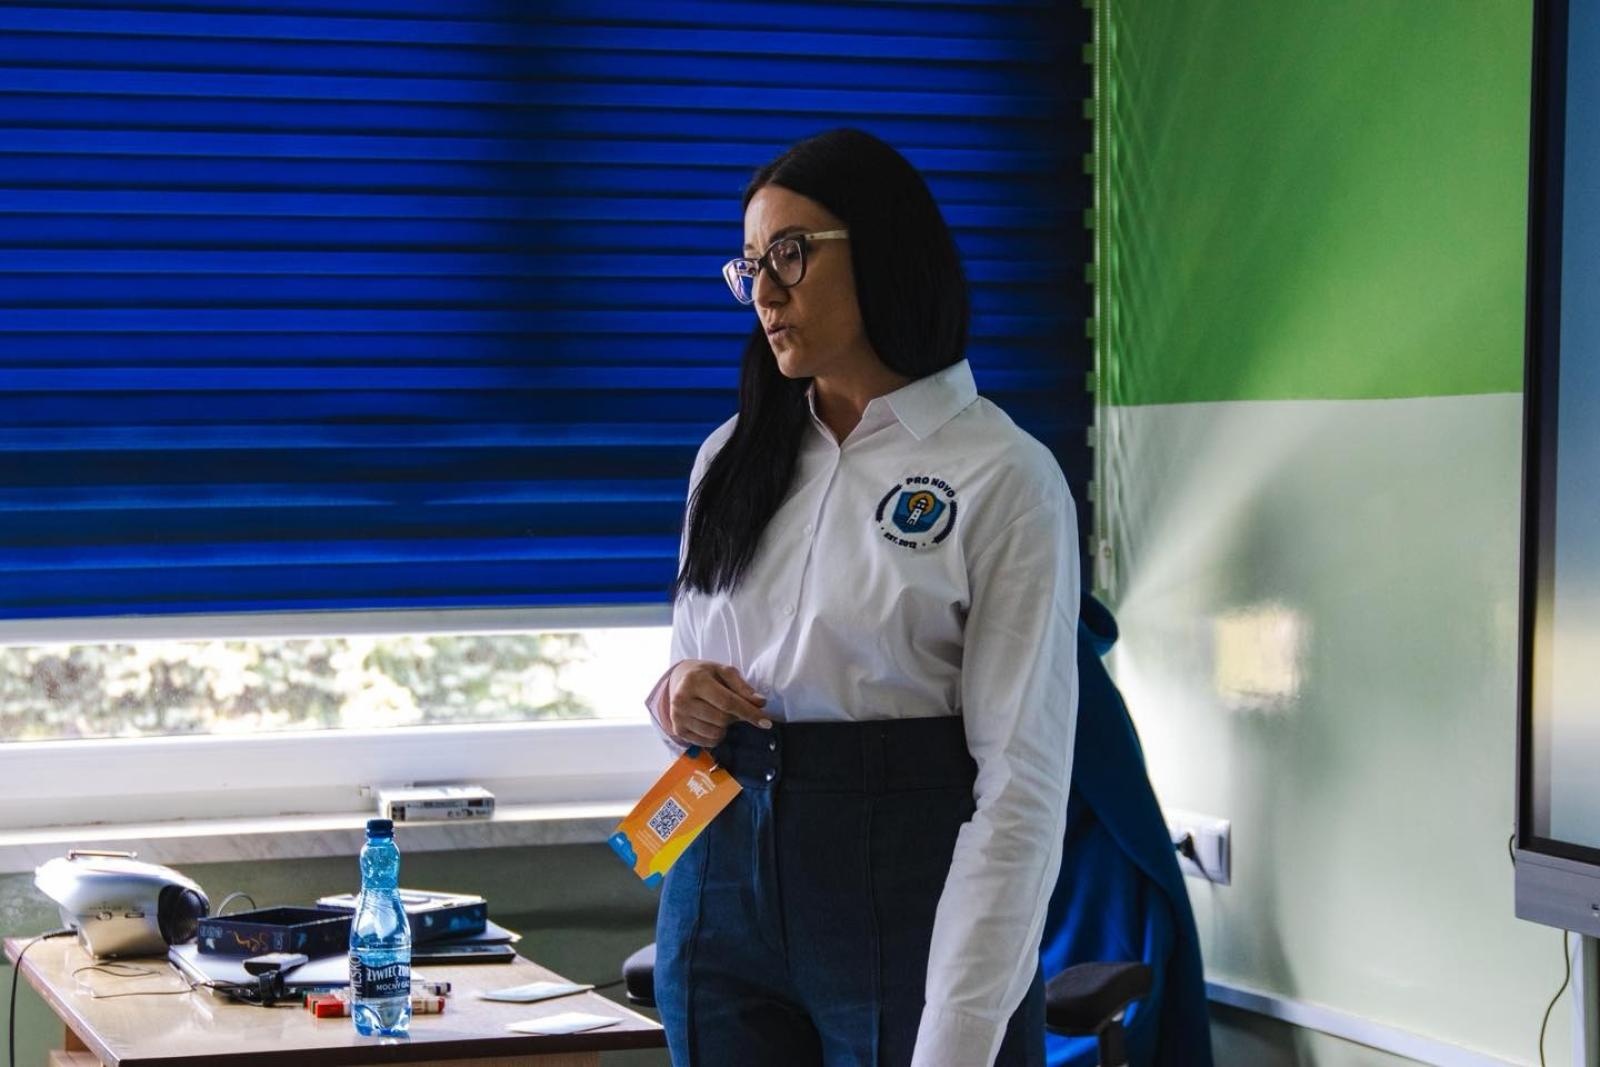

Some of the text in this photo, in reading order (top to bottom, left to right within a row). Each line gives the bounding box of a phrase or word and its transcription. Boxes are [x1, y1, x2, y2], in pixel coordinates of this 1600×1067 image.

[906, 476, 955, 498] PRO NOVO
[884, 532, 898, 544] EST.
